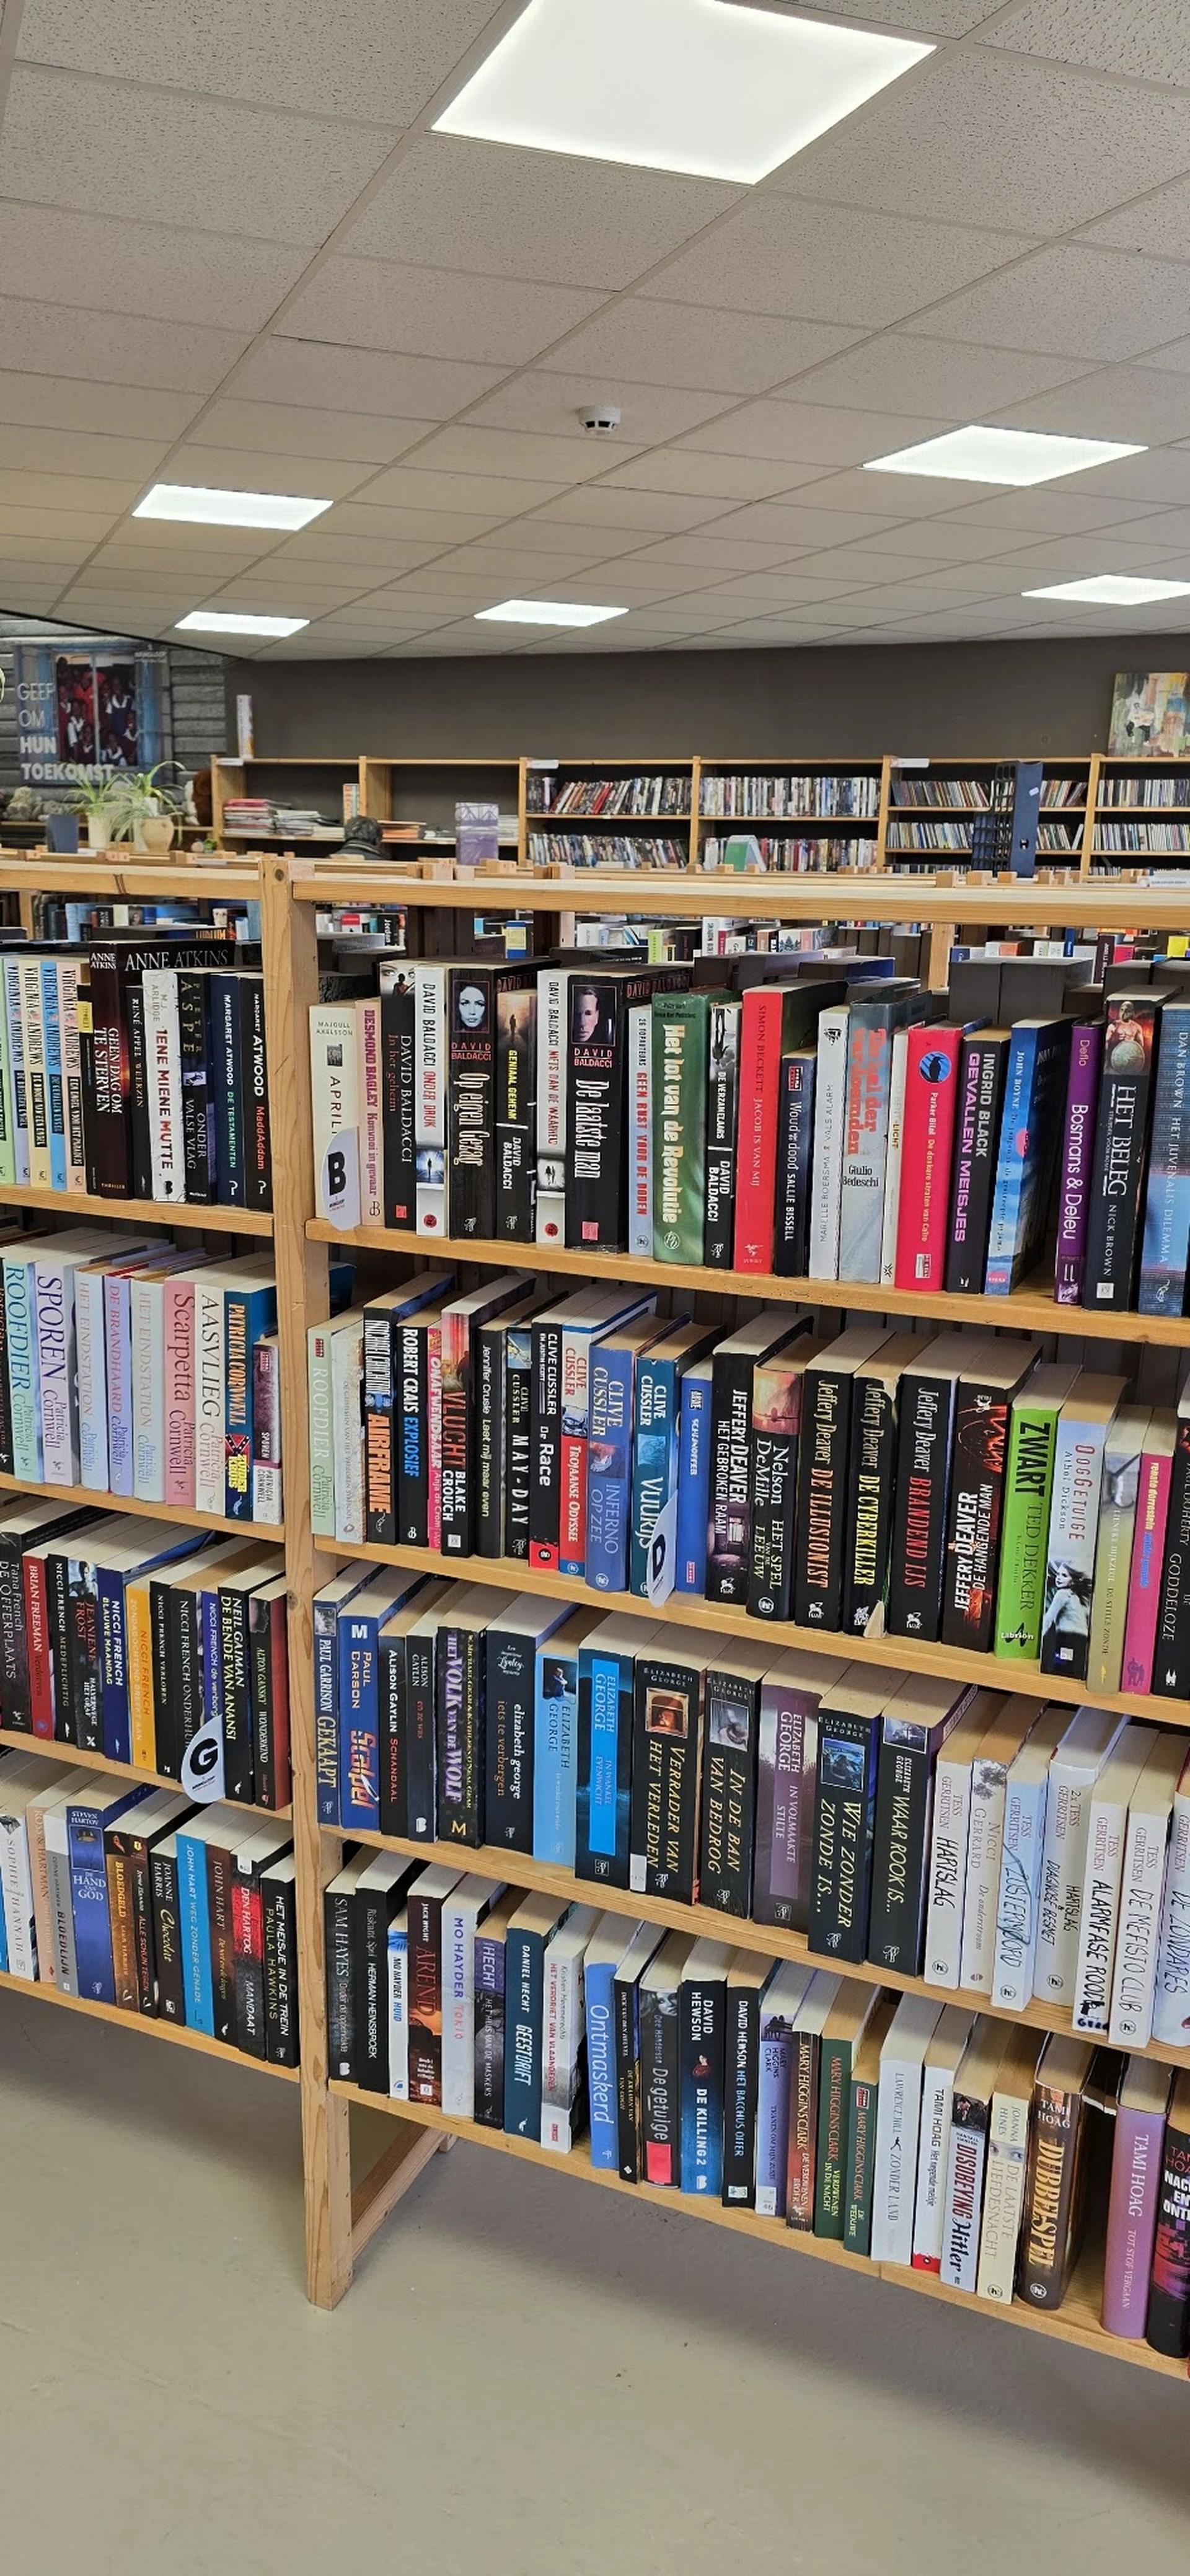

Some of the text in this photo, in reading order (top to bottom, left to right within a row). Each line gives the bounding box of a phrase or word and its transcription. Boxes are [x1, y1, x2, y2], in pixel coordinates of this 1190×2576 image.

[17, 683, 55, 700] GEEF
[19, 710, 45, 727] OM
[20, 736, 56, 754] HUN
[21, 763, 113, 780] TOEKOMST
[90, 953, 117, 970] ANNE ATKINS
[125, 950, 229, 971] ANNE ATKINS
[318, 1021, 350, 1029] MAJGULL
[364, 1010, 378, 1108] DESMOND BAGLEY
[451, 1043, 491, 1051] DAVID
[451, 1052, 491, 1061] BALDACCI
[756, 1005, 766, 1093] SIMON BECKETT
[94, 1027, 110, 1113] TE STERVEN
[224, 994, 237, 1168] MARGARET ATWOOD DE TESTAMENTEN
[252, 1036, 264, 1170] ATWOOD MaddAddam
[400, 1035, 413, 1163] DAVID BALDACCI
[976, 1054, 995, 1158] INGRID BLACK
[454, 1073, 490, 1167] Op eigen Gezag
[575, 1079, 609, 1178] De laatste man
[660, 1025, 685, 1224] Het lot van de Revolutie
[954, 1053, 980, 1242] GEVALLEN MEISJES
[1108, 1085, 1137, 1196] HET BELEG
[328, 1152, 346, 1196] B
[848, 1165, 873, 1175] Giulio
[1063, 1105, 1088, 1240] Bosmans & Deleu
[5, 1267, 31, 1389] ROOFDIER
[37, 1276, 66, 1381] SPOREN
[166, 1294, 195, 1401] Scarpetta
[200, 1294, 221, 1418] AASVLIEG
[228, 1303, 246, 1426] PATRICIA CORNWELL
[403, 1328, 420, 1478] ROBERT CRAIS EXPLOSIEF
[442, 1391, 465, 1468] VLUCHT
[592, 1366, 608, 1437] CUSSLER
[606, 1382, 624, 1428] CLIVE
[369, 1414, 391, 1514] AIRFRAME
[539, 1444, 554, 1486] Race
[728, 1389, 747, 1504] JEFFERY DEAVER
[754, 1439, 772, 1507] DeMille
[770, 1446, 790, 1505] Nelson
[904, 1387, 939, 1587] Jeffery Deaver BRANDEND IJS
[1015, 1421, 1051, 1497] ZWART
[442, 1470, 455, 1522] CROUCH
[454, 1470, 466, 1513] BLAKE
[567, 1445, 582, 1543] TROJAANSE ODYSSEE
[589, 1488, 603, 1543] OPZEE
[604, 1484, 620, 1555] INFERNO
[808, 1468, 833, 1588] DE ILLUSIONIST
[853, 1475, 879, 1586] DE CYBERKILLER
[1001, 1632, 1034, 1640] Librion
[1162, 1553, 1181, 1641] GODDELOZE
[112, 1600, 123, 1687] NICCI FRENCH
[221, 1596, 236, 1740] DE BENDE VAN ANANSI
[232, 1598, 245, 1687] NEIL GAIMAN
[351, 1651, 359, 1708] CARSON
[363, 1652, 372, 1687] PAUL
[317, 1639, 337, 1788] PAUL GARRISON GEKAAPT
[389, 1649, 398, 1802] ALISON GAYLIN SCHANDAAL
[511, 1704, 525, 1799] elizabeth george
[190, 1738, 218, 1776] G
[350, 1730, 377, 1809] Scalpel
[646, 1740, 663, 1868] HET VERLEDEN
[667, 1746, 685, 1872] VERRADER VAN
[819, 1799, 835, 1869] ZONDE
[889, 1796, 909, 1887] WAAR ROOK
[73, 1875, 106, 1887] HAND
[77, 1890, 104, 1901] GOD
[838, 1802, 861, 1928] WIE ZONDER
[933, 1836, 959, 1909] HARTSLAG
[241, 1887, 255, 2036] DEN HARTOG MANDAAT
[266, 1908, 277, 2019] PAULA HAWKINS
[454, 1917, 464, 1999] MO HAYDER
[1086, 1880, 1113, 1962] ALARMFASE
[1119, 1889, 1154, 2012] DE MEFISTO CLUB
[275, 1896, 288, 2036] HET MEISJE IN DE TREIN
[415, 1945, 436, 2016] AREND
[691, 1992, 702, 2042] HEWSON
[703, 1999, 713, 2035] DAVID
[590, 2004, 614, 2124] Ontmaskerd
[650, 2068, 671, 2140] De getuige
[1039, 2099, 1072, 2115] TAMI
[695, 2088, 708, 2166] DE KILLING 2
[1037, 2112, 1070, 2130] HOAG
[948, 2143, 977, 2273] DISOBEYING Hitler
[1028, 2139, 1065, 2268] DUBBELSPEL
[1129, 2134, 1149, 2217] TAMI HOAG
